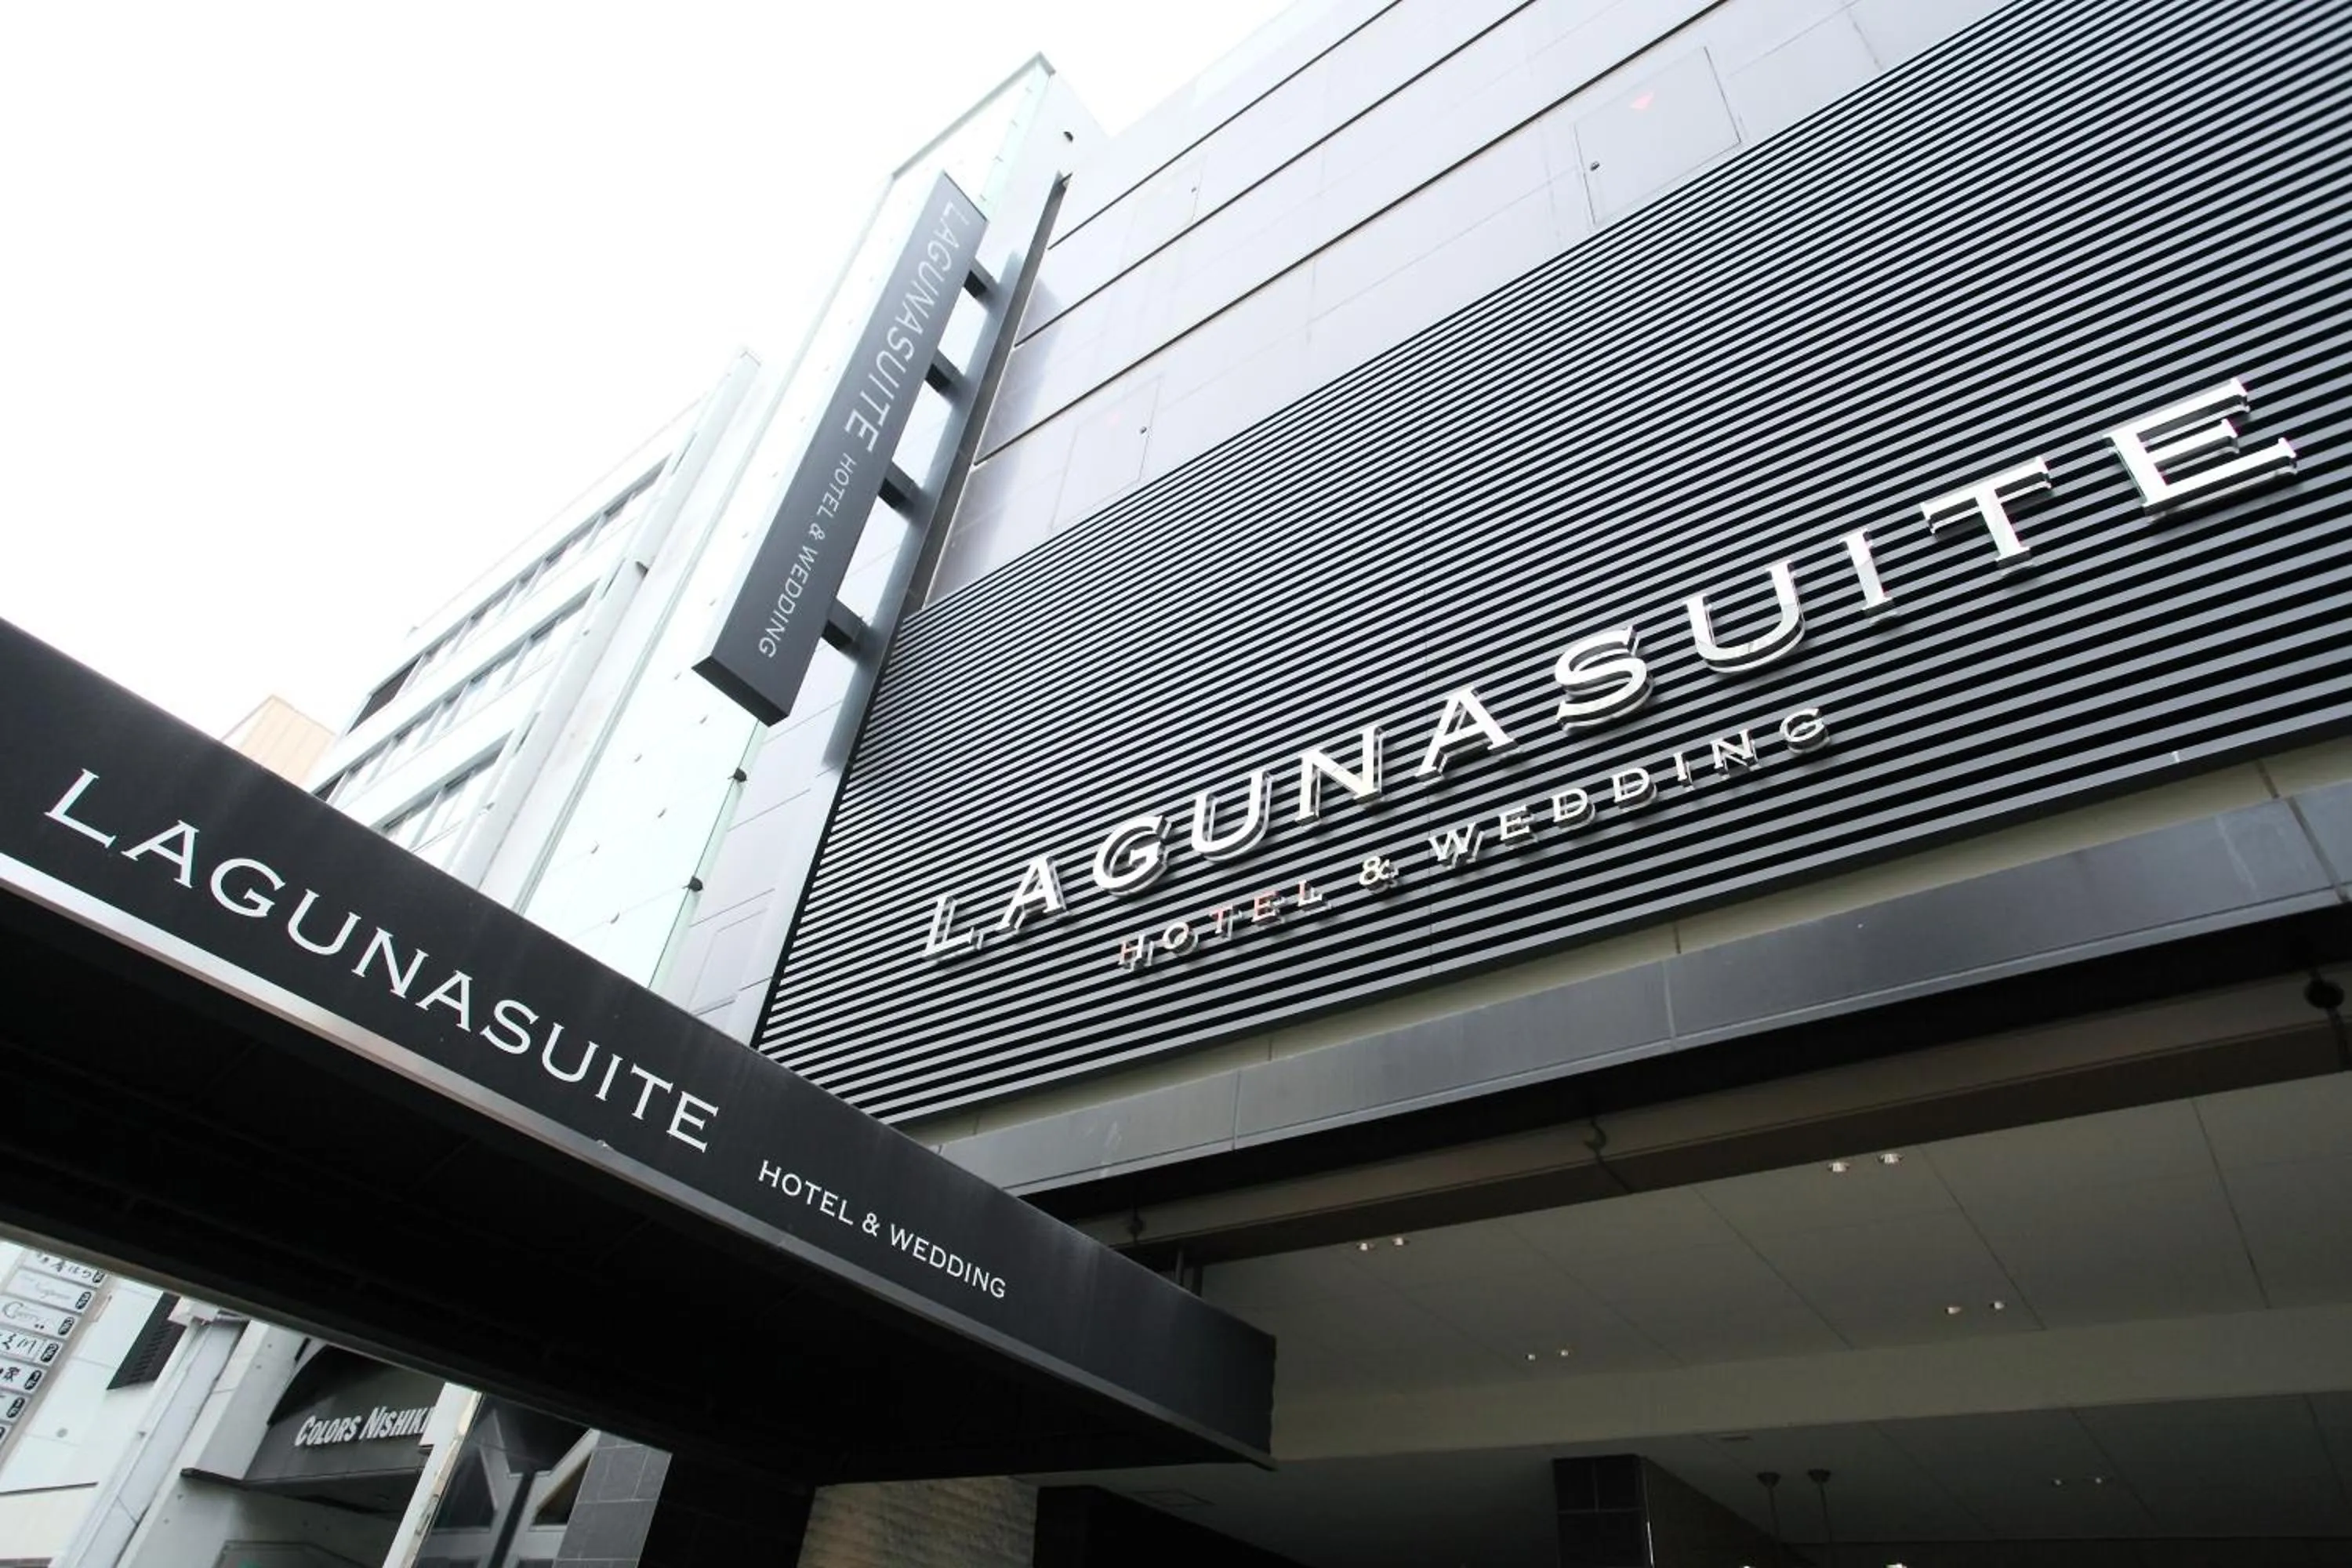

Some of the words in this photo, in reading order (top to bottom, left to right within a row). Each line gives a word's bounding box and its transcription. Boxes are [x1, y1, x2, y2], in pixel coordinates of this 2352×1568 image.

[844, 198, 971, 453] LAGUNASUITE
[810, 521, 827, 541] &
[815, 451, 858, 519] HOTEL
[758, 547, 819, 659] WEDDING
[922, 377, 2299, 961] LAGUNASUITE
[1119, 878, 1330, 972] HOTEL
[1359, 855, 1399, 891] &
[1428, 707, 1831, 869] WEDDING
[45, 768, 719, 1152] LAGUNASUITE
[758, 1160, 854, 1225] HOTEL
[862, 1212, 880, 1237] &
[890, 1223, 1007, 1299] WEDDING
[294, 1415, 363, 1446] COLORS
